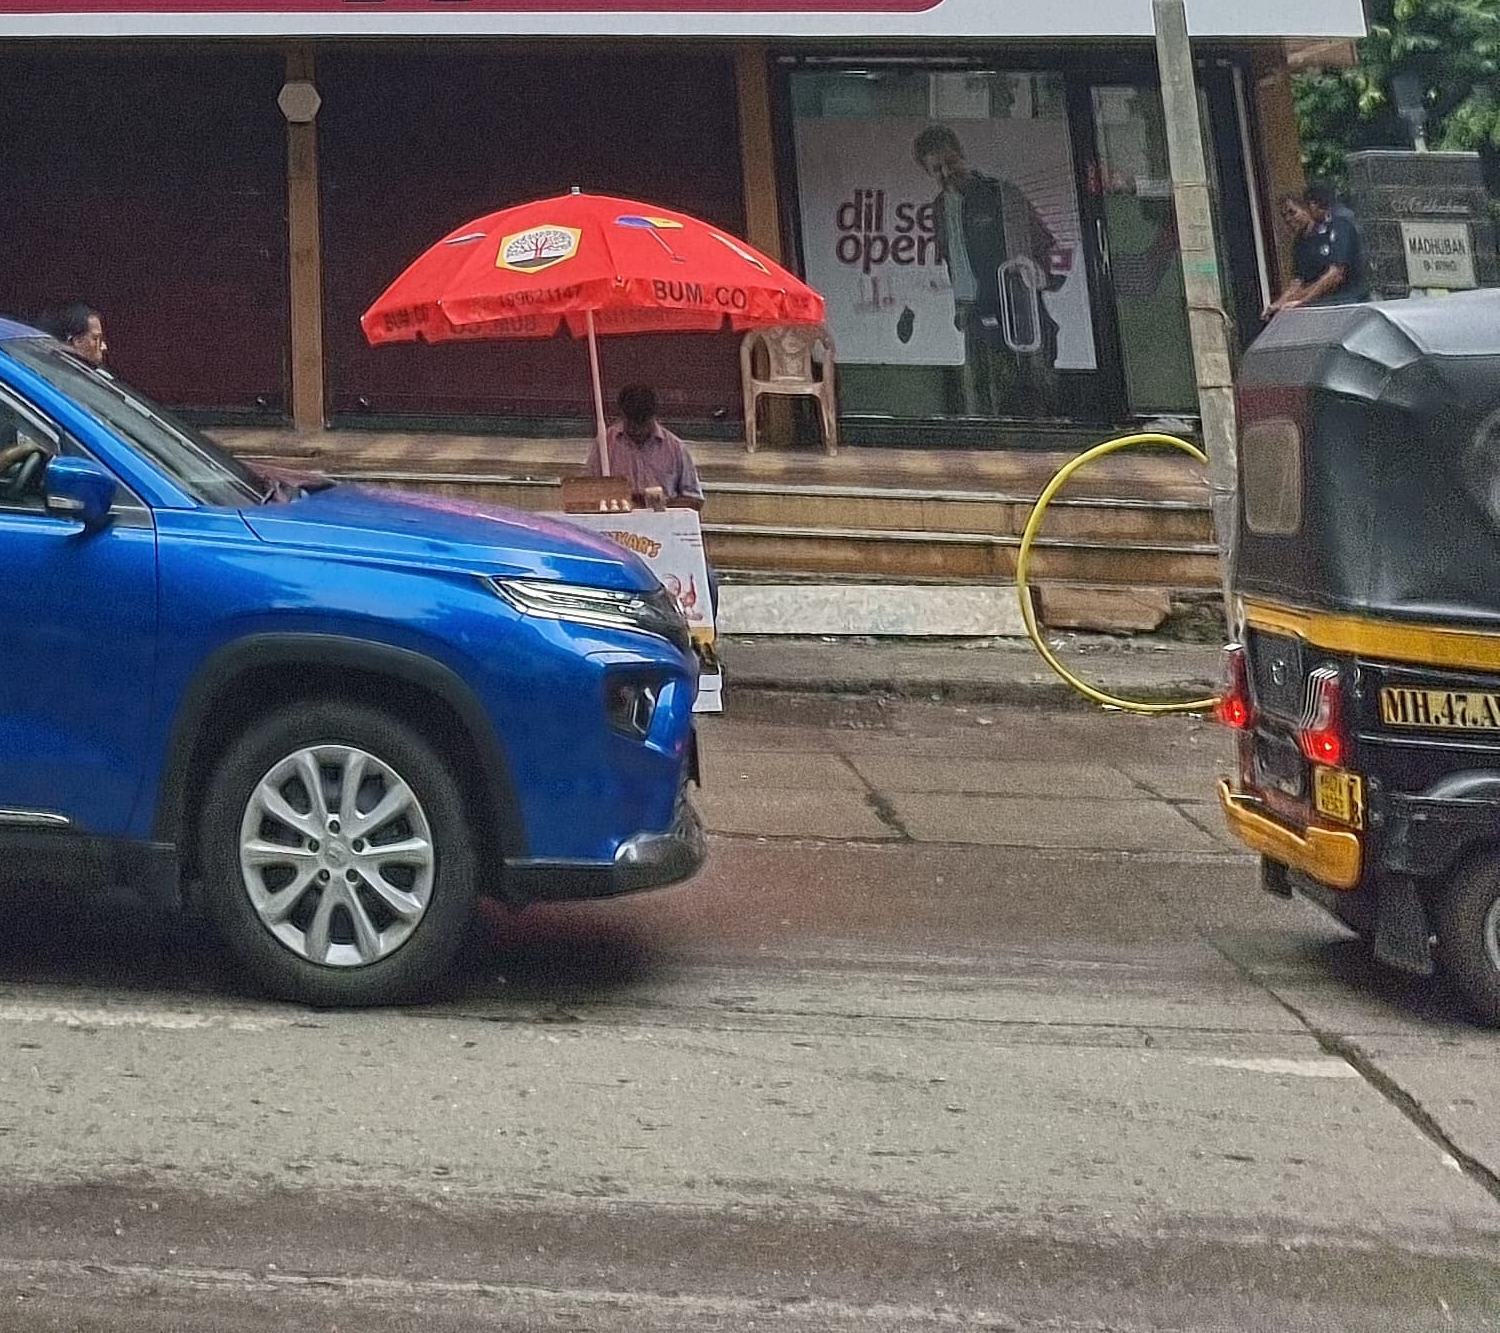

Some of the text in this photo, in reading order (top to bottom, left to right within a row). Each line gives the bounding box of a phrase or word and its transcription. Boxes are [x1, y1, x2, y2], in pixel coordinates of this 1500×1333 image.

[836, 189, 936, 234] dil se
[835, 233, 943, 275] open
[1409, 238, 1466, 255] MADHUBAN
